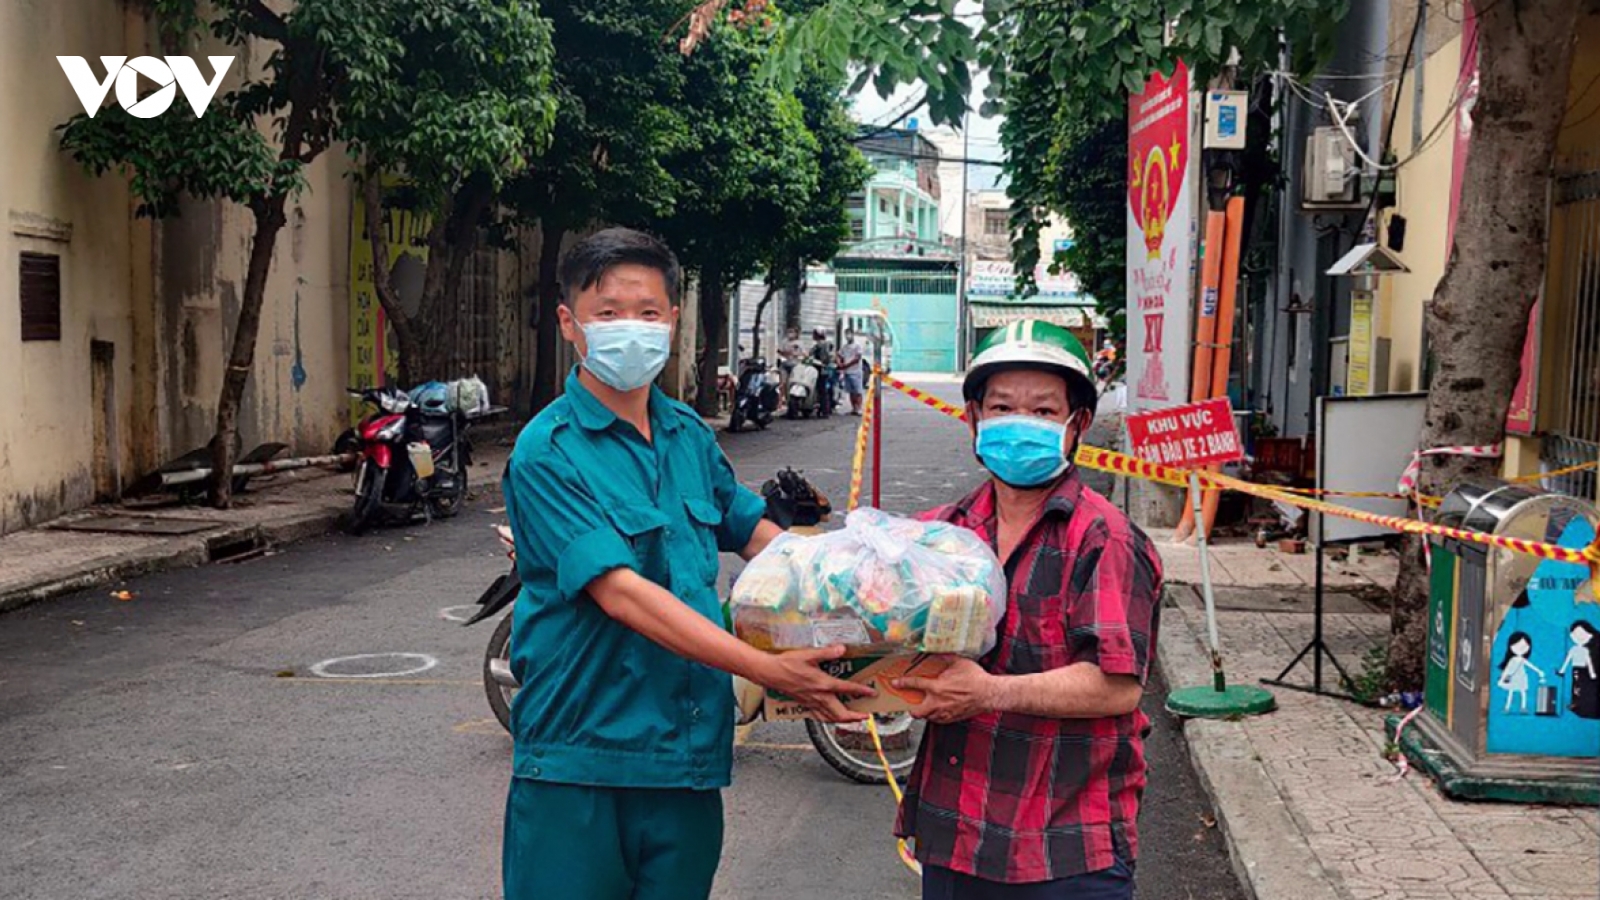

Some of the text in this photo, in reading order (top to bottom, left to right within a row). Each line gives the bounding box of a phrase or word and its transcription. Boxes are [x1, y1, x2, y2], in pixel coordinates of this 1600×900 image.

[1147, 409, 1212, 433] KHU VỰC
[1183, 438, 1198, 458] XE
[1199, 437, 1207, 457] 2
[1206, 428, 1236, 454] BÁNH
